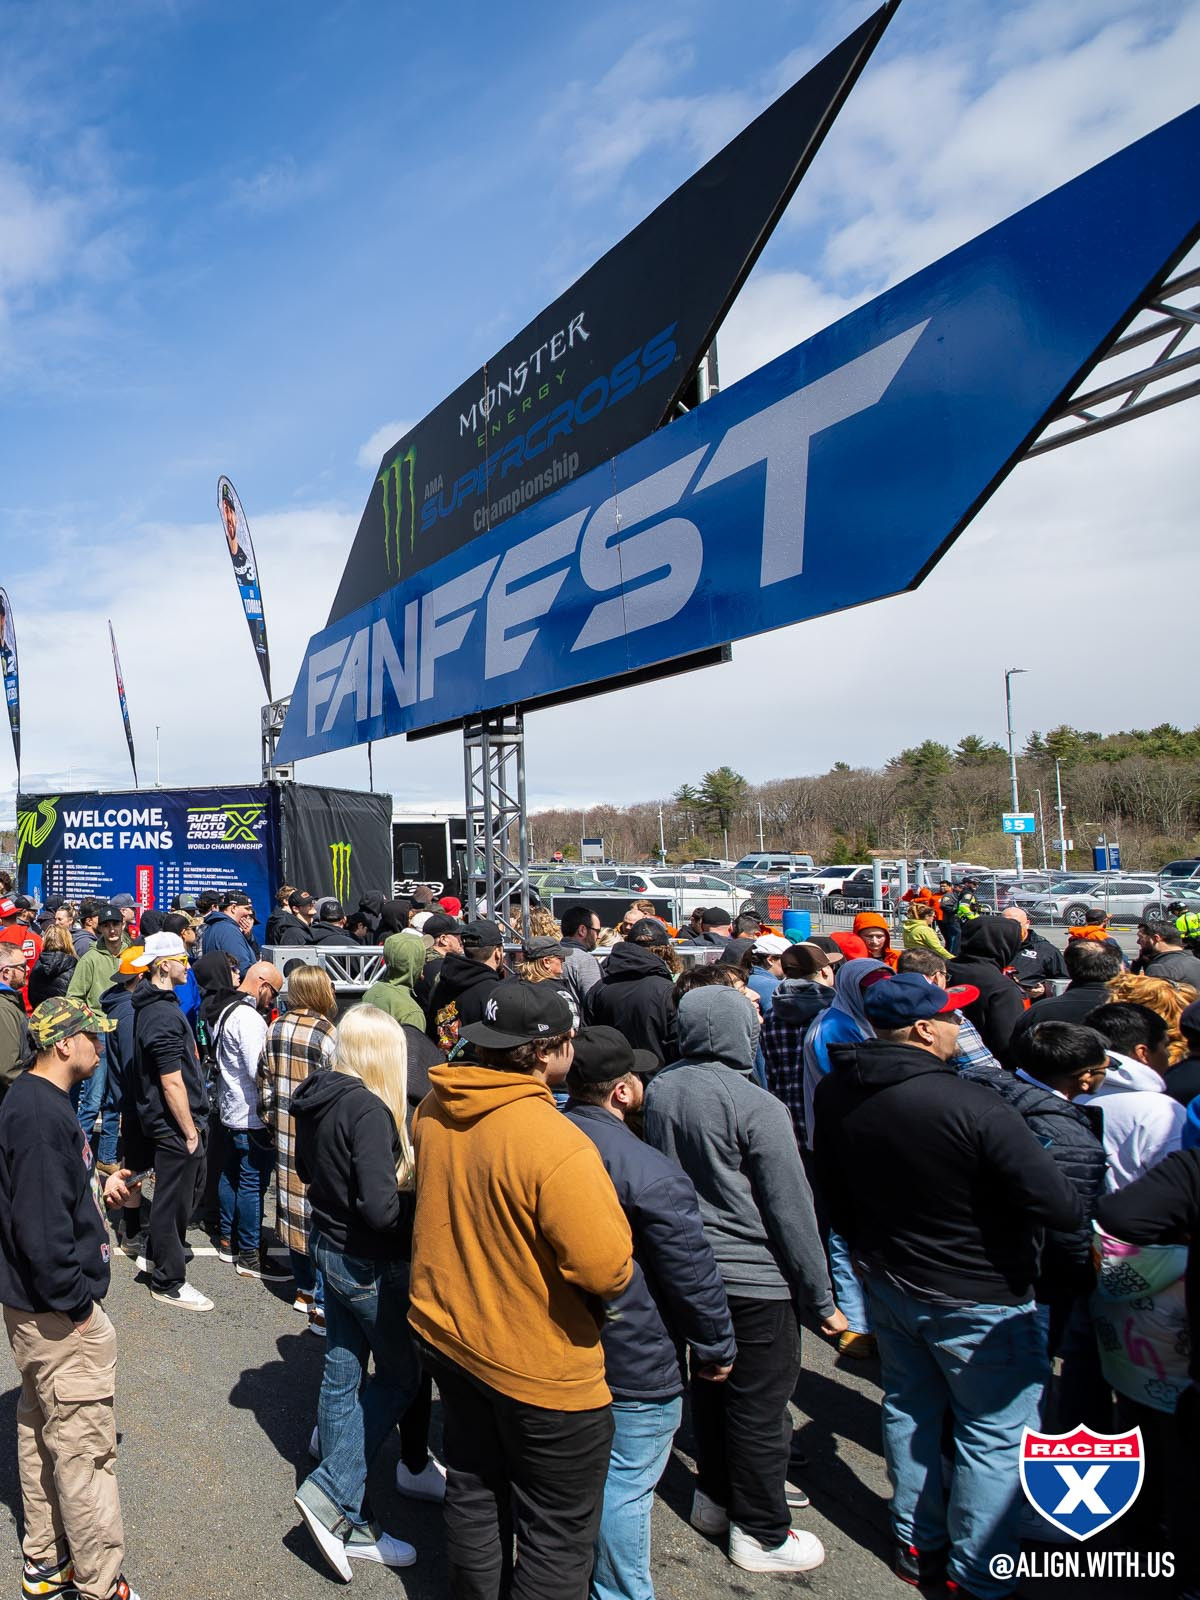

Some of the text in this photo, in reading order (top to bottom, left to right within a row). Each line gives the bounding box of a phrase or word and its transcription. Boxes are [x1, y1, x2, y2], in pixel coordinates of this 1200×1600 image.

[459, 311, 590, 436] MONSTER
[477, 369, 567, 448] ENERGY
[420, 320, 678, 533] SUPERCROSS
[424, 474, 444, 500] AMA
[473, 452, 579, 531] Championship
[306, 317, 932, 736] FANFEST
[63, 808, 168, 830] WELCOME,
[187, 814, 227, 822] SUPER
[189, 822, 225, 830] MOTO
[1014, 820, 1025, 830] 5
[63, 830, 173, 849] RACE FANS
[186, 831, 226, 839] CROSS
